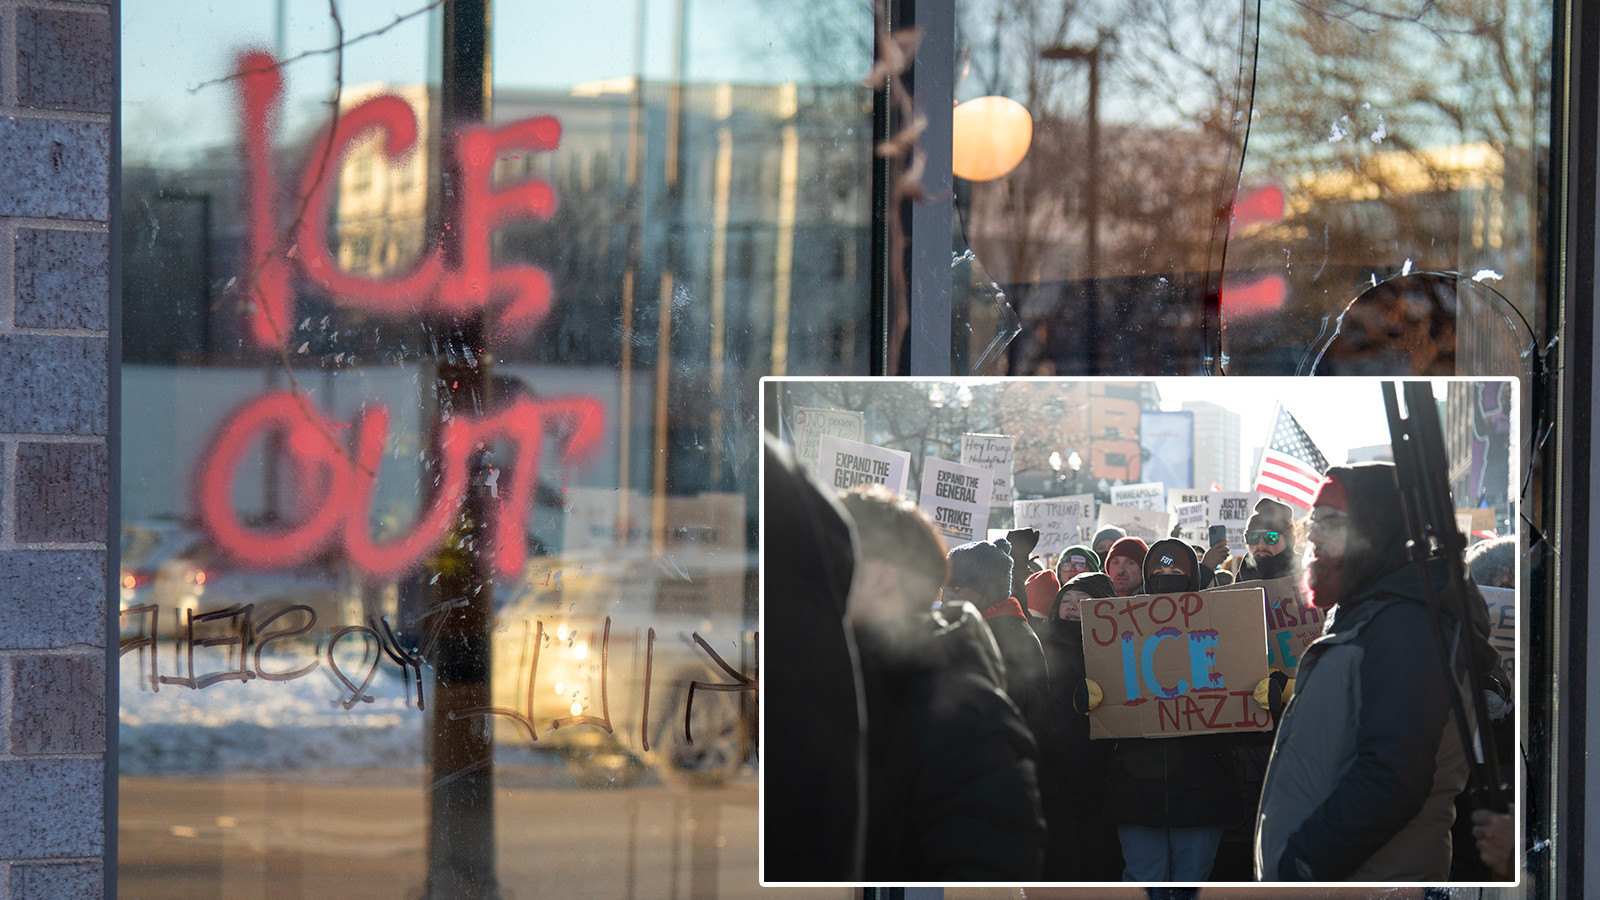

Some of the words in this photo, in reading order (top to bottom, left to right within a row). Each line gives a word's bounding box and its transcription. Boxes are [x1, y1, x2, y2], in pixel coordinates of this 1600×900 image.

[231, 47, 562, 349] ICE
[806, 413, 825, 427] NO
[965, 438, 985, 457] Hey
[835, 452, 871, 472] EXPAND
[872, 460, 891, 477] THE
[197, 390, 606, 580] OUT
[937, 470, 965, 487] EXPAND
[965, 476, 979, 489] THE
[935, 482, 977, 504] GENERAL
[1221, 498, 1248, 509] JUSTICE
[935, 505, 972, 527] STRIKE!
[1045, 503, 1080, 517] TRUMP
[1219, 509, 1233, 520] FOR
[1160, 555, 1174, 566] FDT
[1264, 586, 1320, 630] lish
[1091, 593, 1204, 647] STOP
[1121, 627, 1226, 706] ICE
